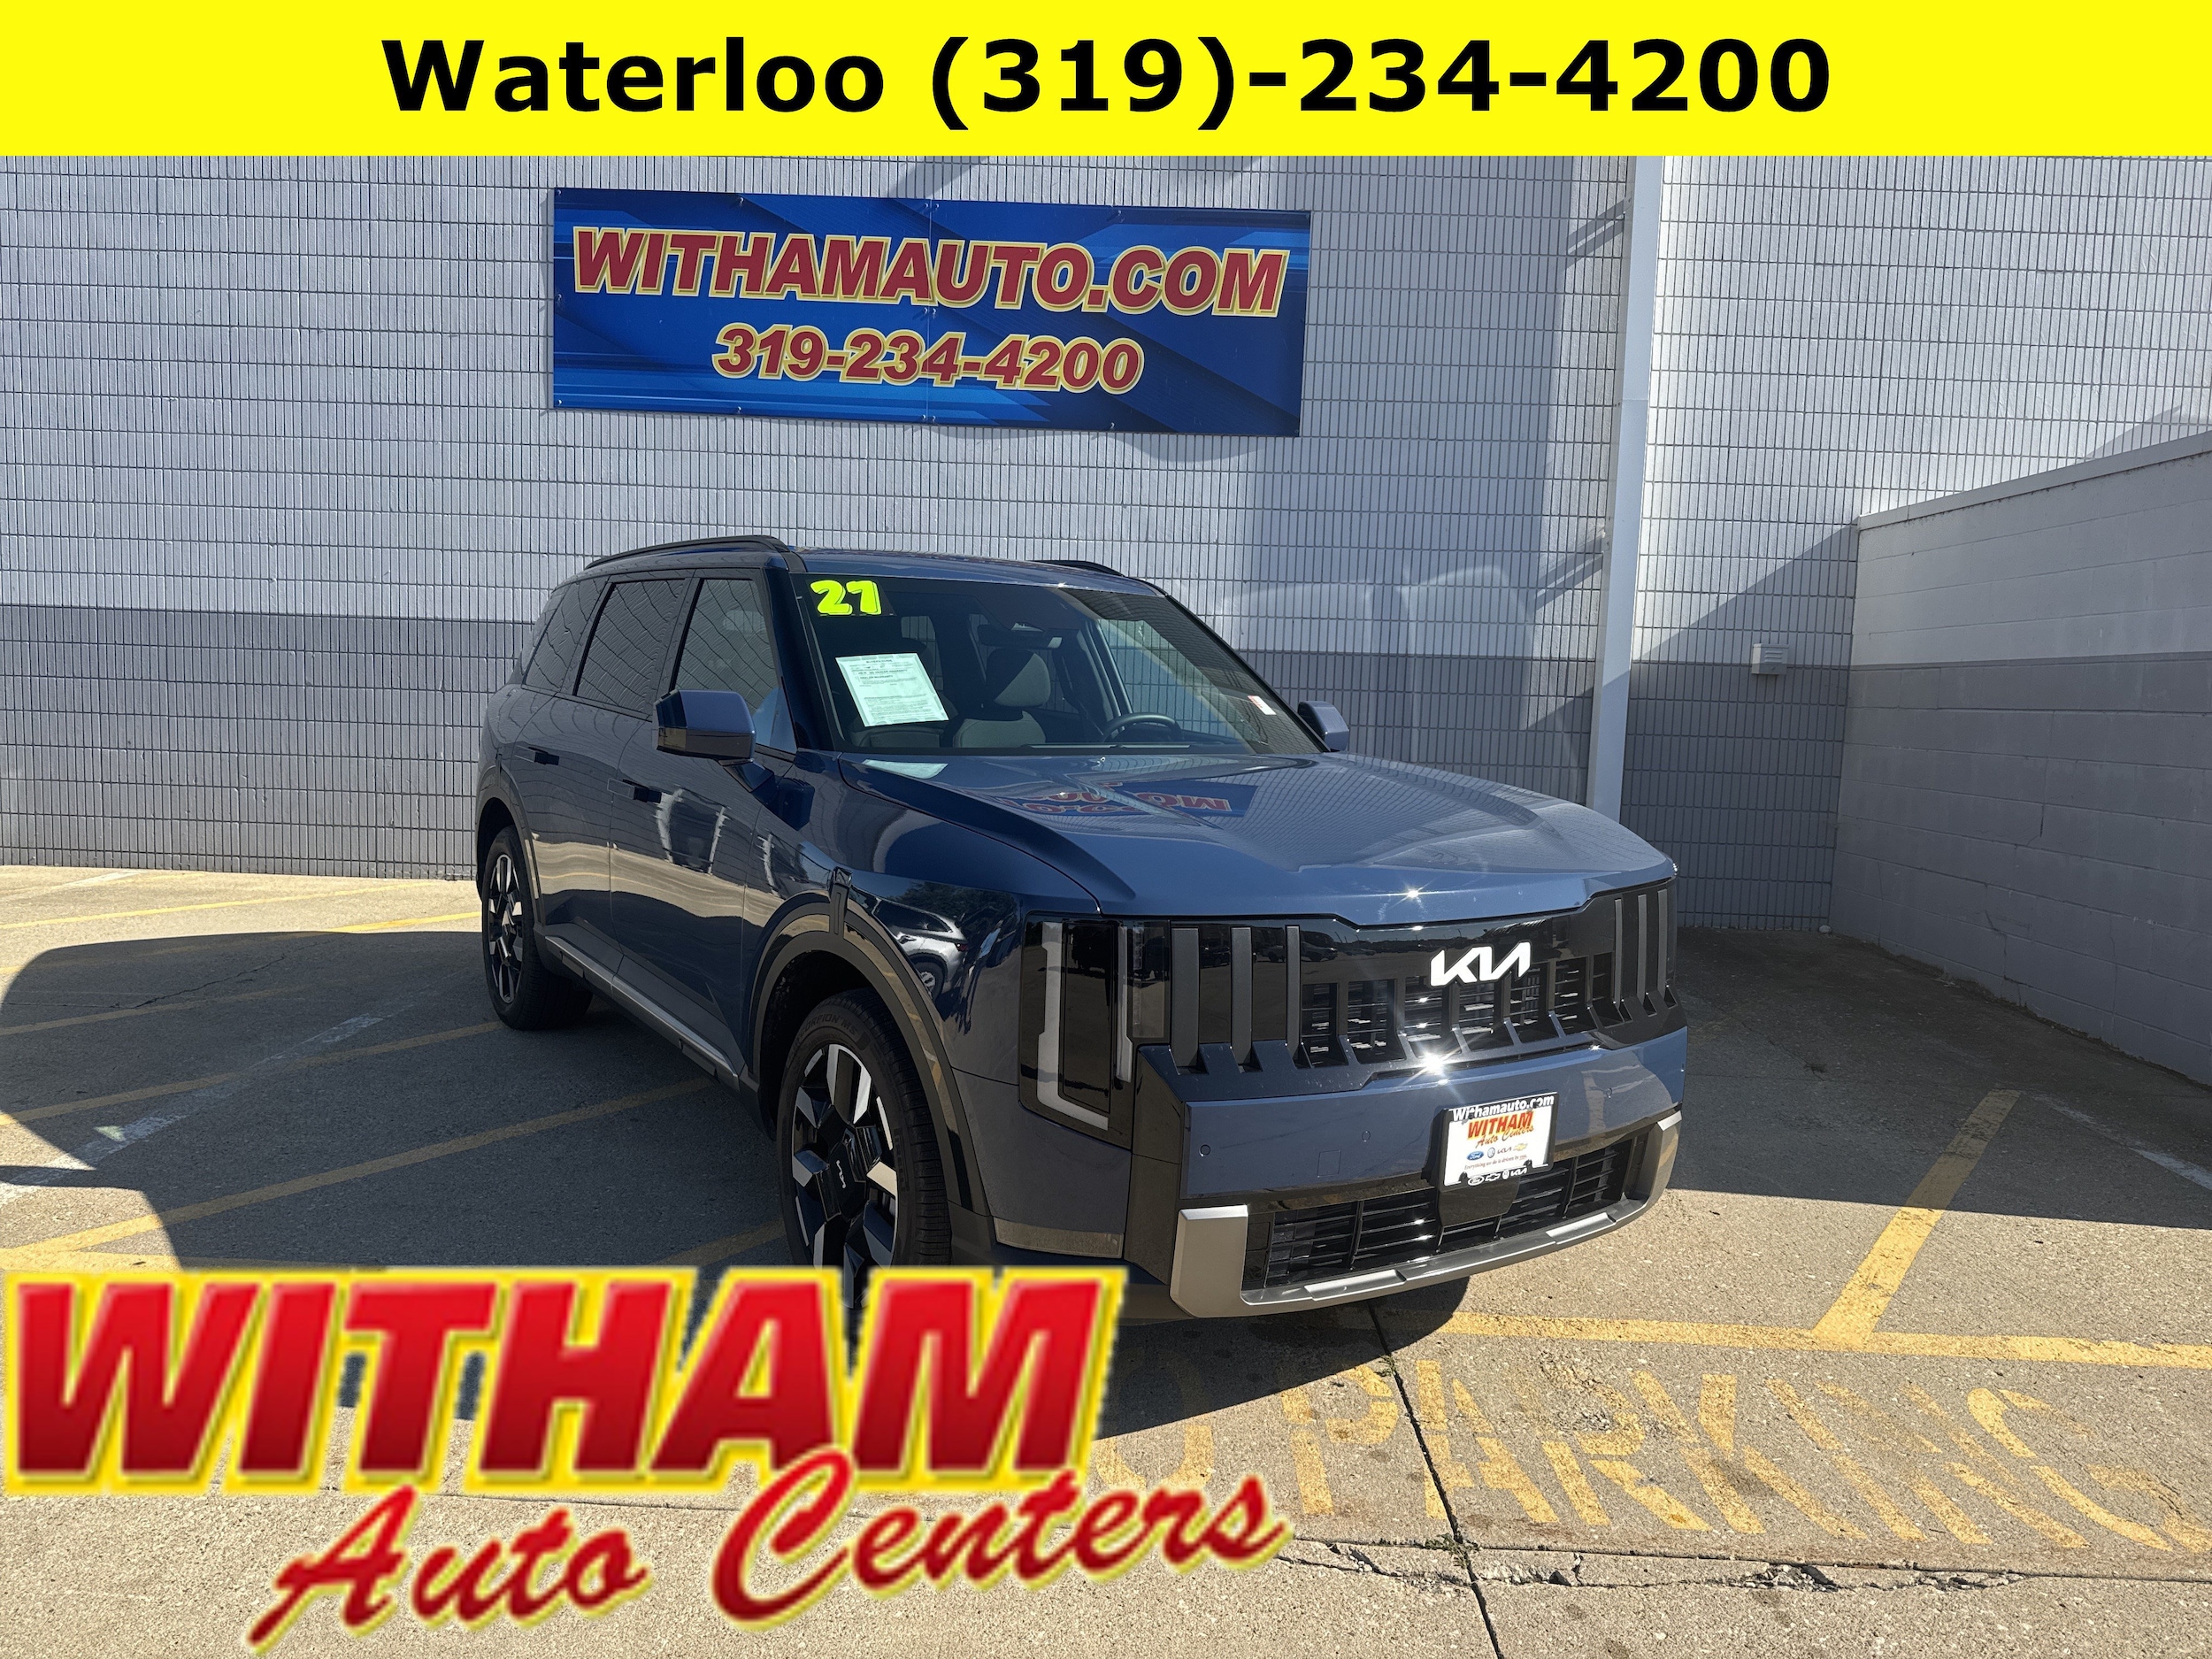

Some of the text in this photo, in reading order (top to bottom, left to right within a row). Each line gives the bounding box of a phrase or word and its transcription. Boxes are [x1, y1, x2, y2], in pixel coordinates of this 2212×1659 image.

[572, 226, 1291, 318] WITHAMAUTO.COM
[711, 323, 1144, 395] 319-234-4200
[810, 580, 881, 615] 27
[1431, 942, 1531, 987] KIA
[1467, 1111, 1533, 1139] WITHAM
[1475, 1134, 1499, 1148] Auto
